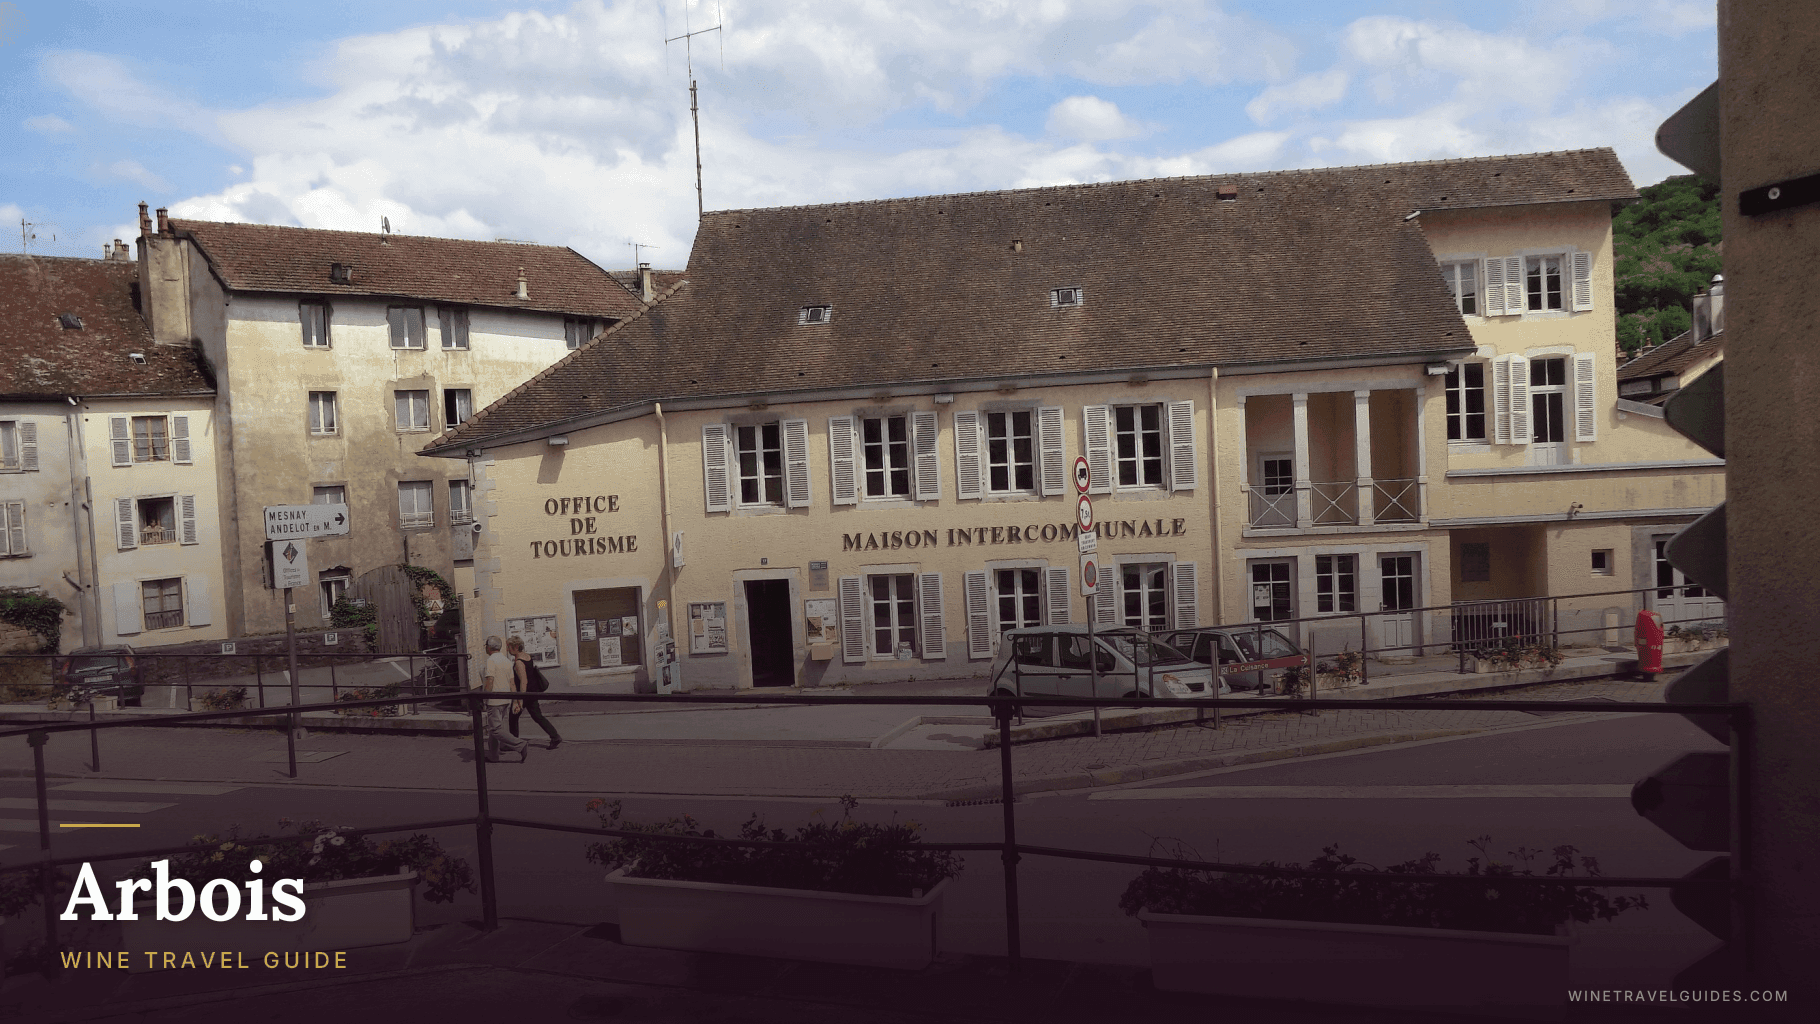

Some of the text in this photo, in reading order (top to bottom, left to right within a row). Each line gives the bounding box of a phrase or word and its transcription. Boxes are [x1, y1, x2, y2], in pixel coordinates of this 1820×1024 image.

[544, 495, 620, 516] OFFICE
[269, 510, 306, 521] MESNAY
[270, 523, 309, 534] ANDELOT
[570, 517, 597, 536] DE
[530, 535, 638, 559] TOURISME
[842, 529, 939, 551] MAISON
[1229, 663, 1269, 674] La Cuisance
